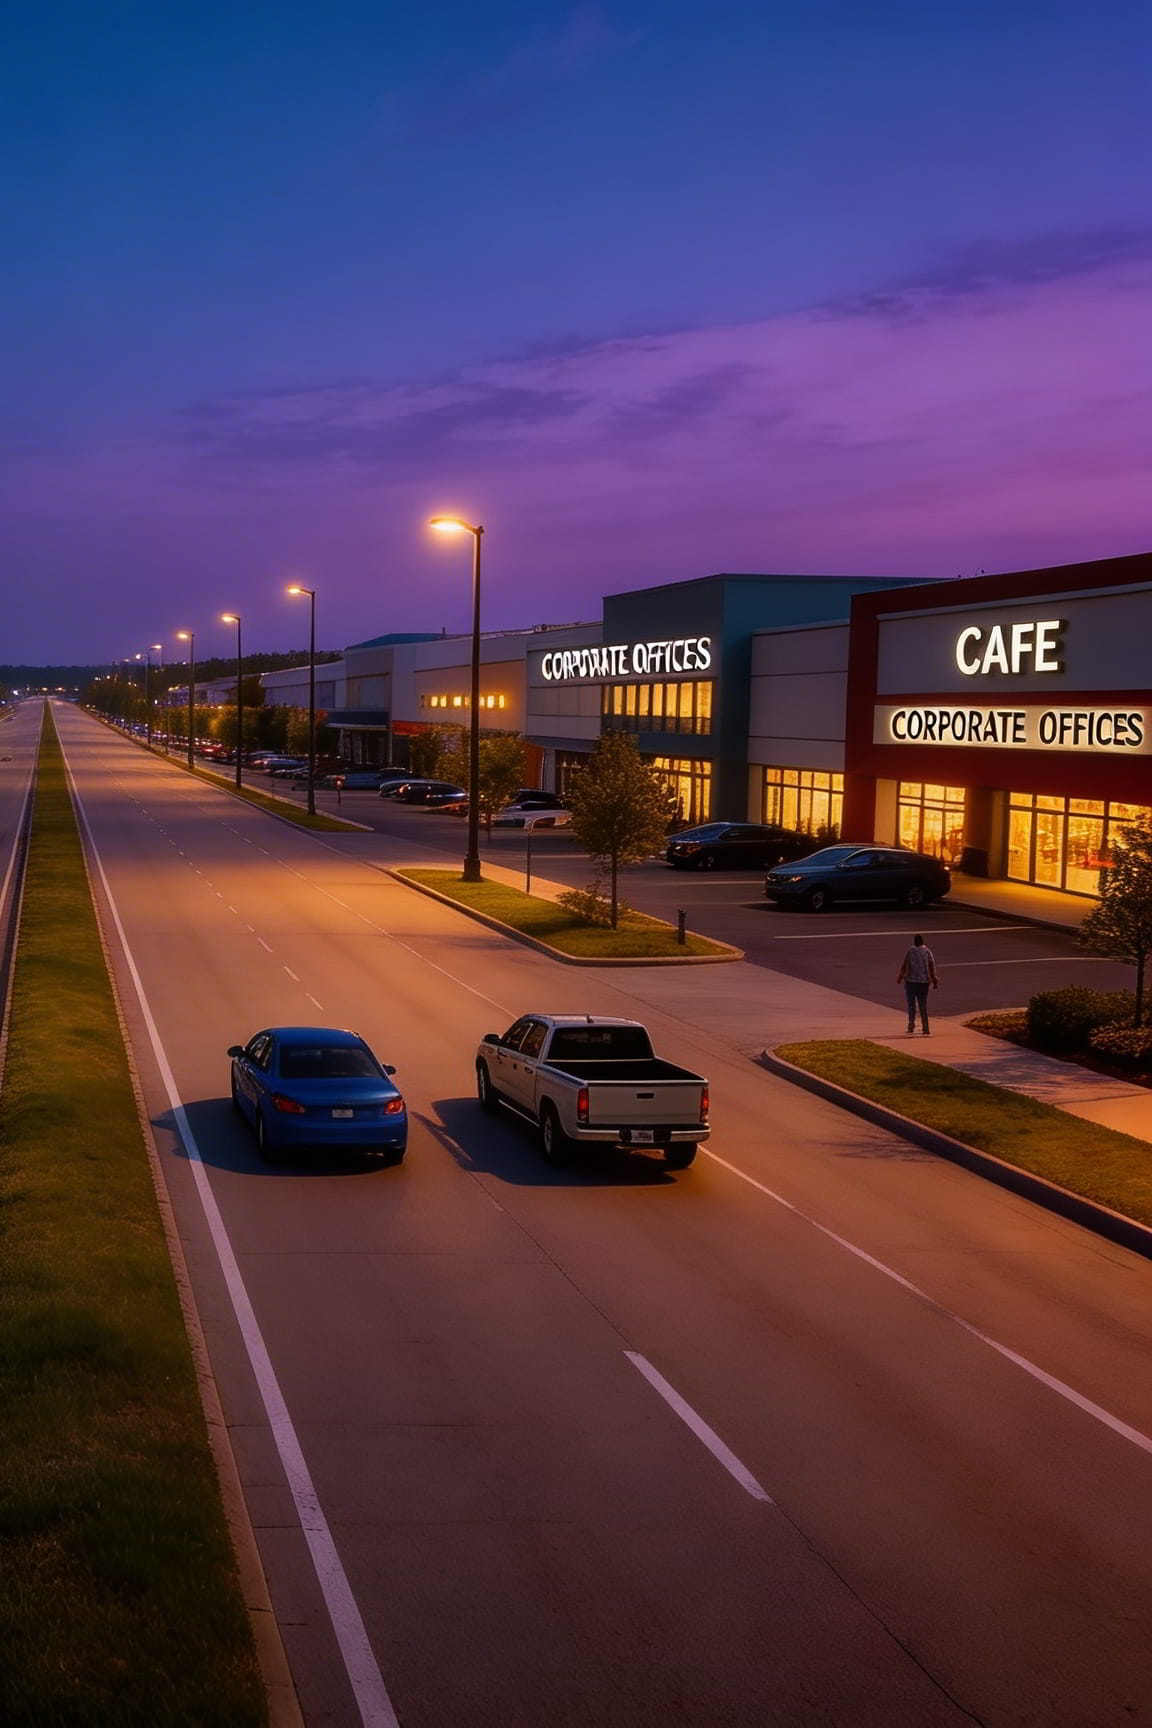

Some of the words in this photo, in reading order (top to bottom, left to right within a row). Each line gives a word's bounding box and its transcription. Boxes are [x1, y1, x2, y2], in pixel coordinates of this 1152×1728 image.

[955, 620, 1060, 676] CAFE
[891, 710, 1027, 743] CORPORATE
[1039, 711, 1144, 747] OFFICES
